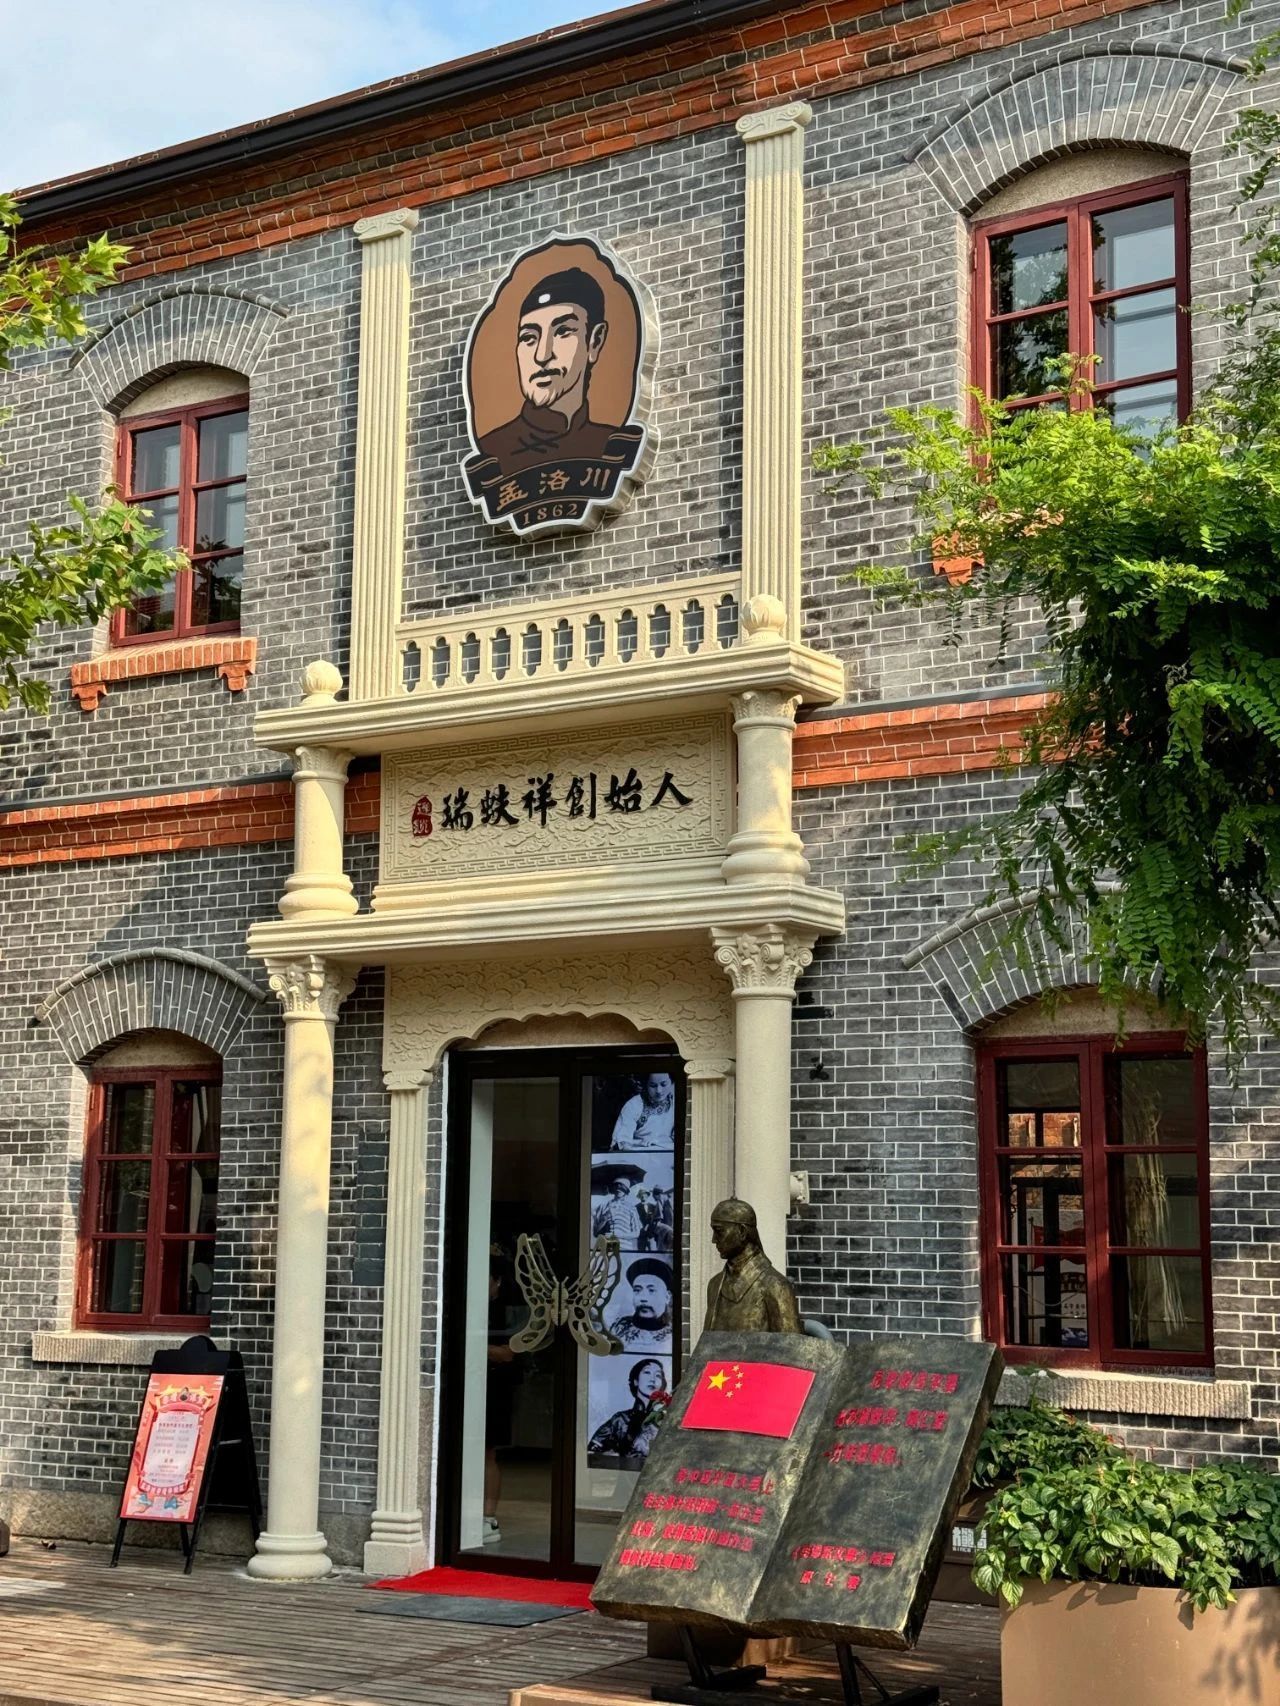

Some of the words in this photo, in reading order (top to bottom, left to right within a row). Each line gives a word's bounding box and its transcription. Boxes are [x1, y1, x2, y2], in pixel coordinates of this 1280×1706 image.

[496, 467, 609, 512] 孟洛川
[523, 503, 578, 525] 1862
[440, 767, 694, 831] 瑞蚨祥創始人
